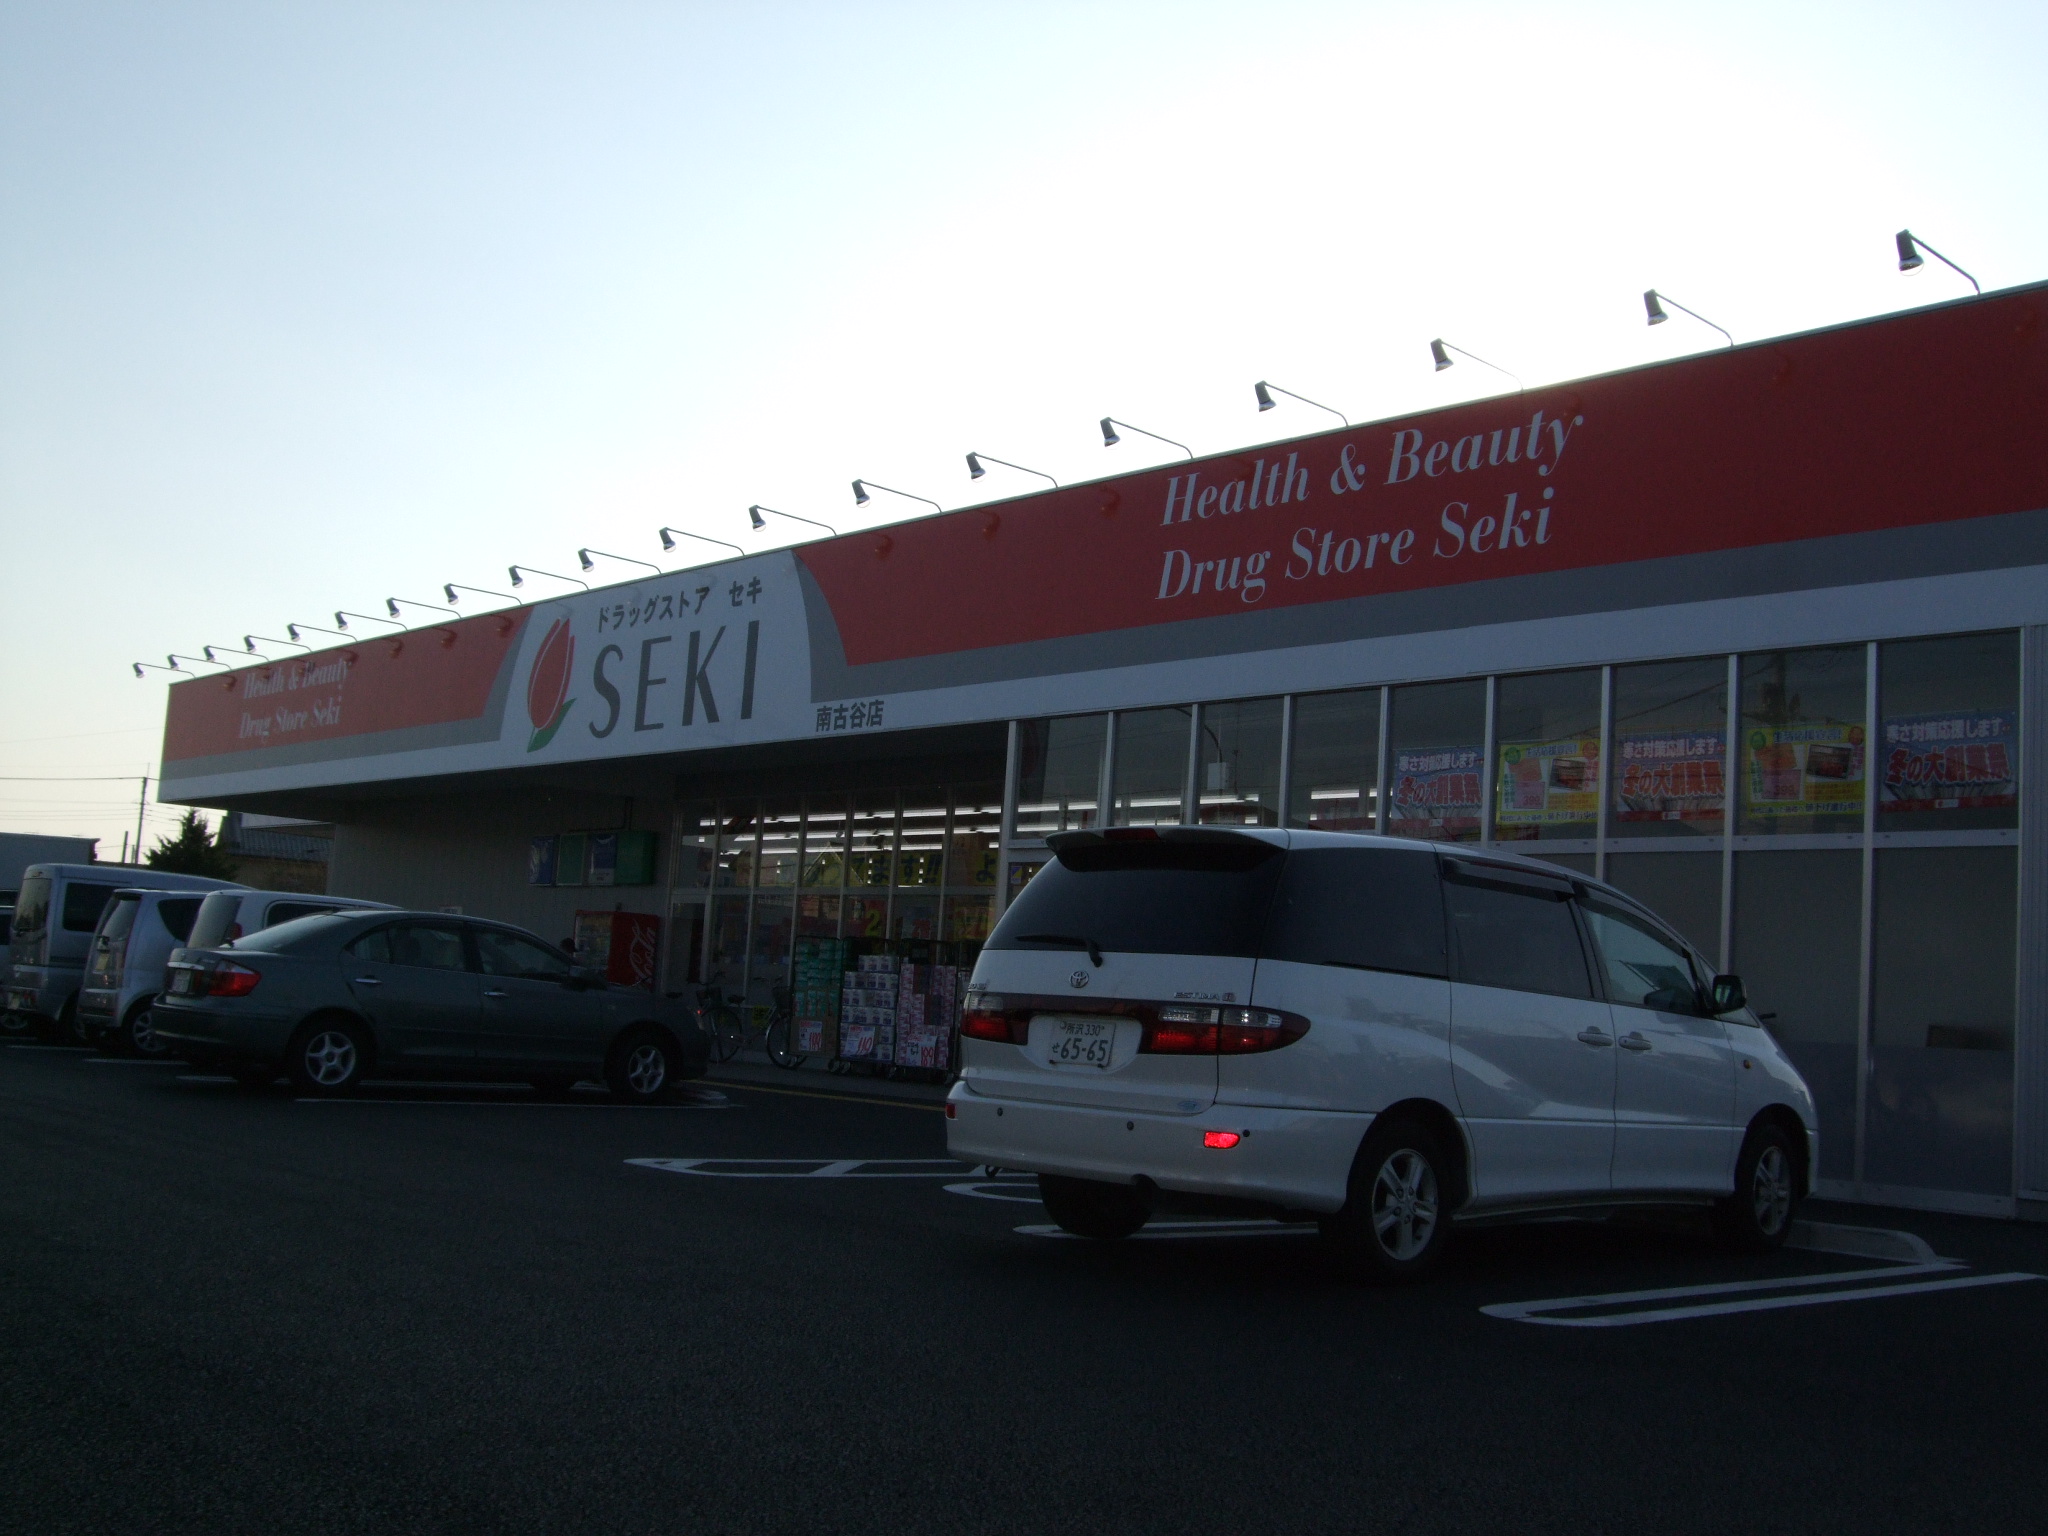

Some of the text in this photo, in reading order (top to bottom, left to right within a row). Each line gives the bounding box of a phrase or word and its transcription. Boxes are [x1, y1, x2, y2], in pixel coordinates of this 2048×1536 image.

[1160, 410, 1584, 526] Health & Beauty
[1154, 486, 1555, 603] Drug Store Seki
[598, 576, 762, 633] ドラッグストア セキ
[588, 619, 760, 739] SEKI
[815, 700, 884, 732] 南古谷店
[1060, 1038, 1109, 1062] 65-65
[1085, 1024, 1101, 1036] 330
